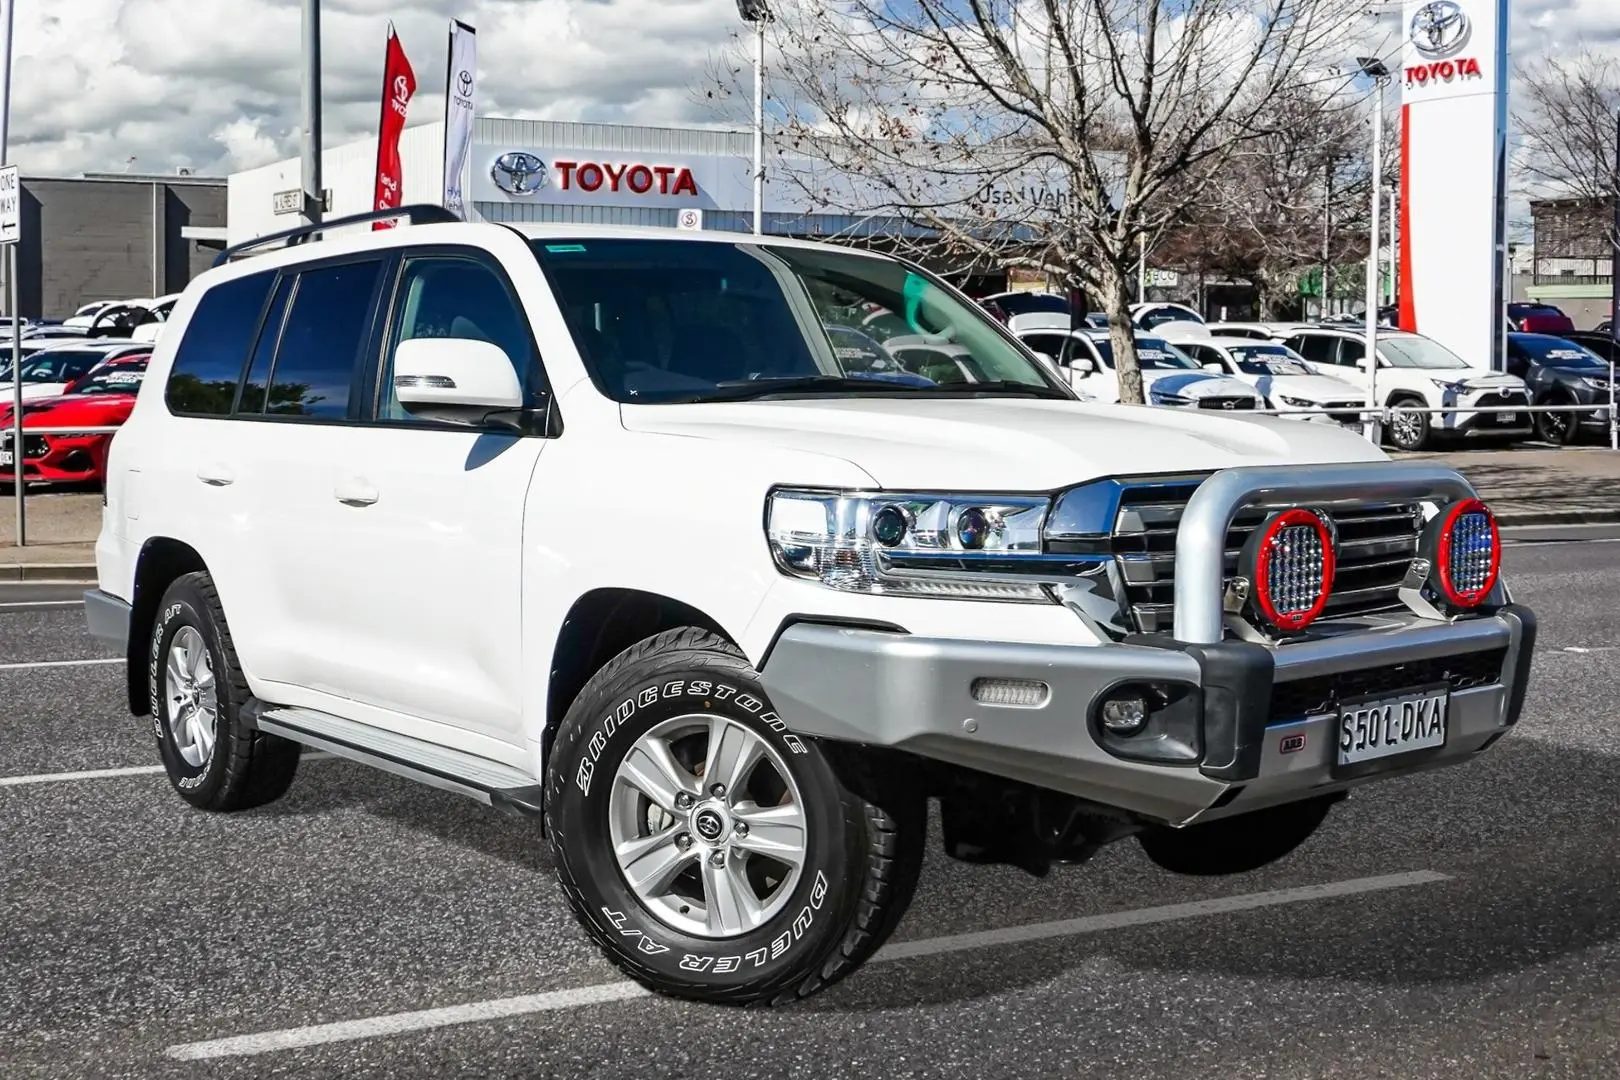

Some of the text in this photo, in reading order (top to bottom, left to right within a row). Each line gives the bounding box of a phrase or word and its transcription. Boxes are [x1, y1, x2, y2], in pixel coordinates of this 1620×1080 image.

[1404, 58, 1482, 83] TOYOTA
[1, 173, 15, 191] ONE
[555, 162, 698, 196] TOYOTA
[0, 196, 16, 214] WAY
[150, 604, 182, 739] DUELER A/T
[576, 680, 808, 796] BRIDGESTONE
[602, 870, 828, 972] DUELER A/T
